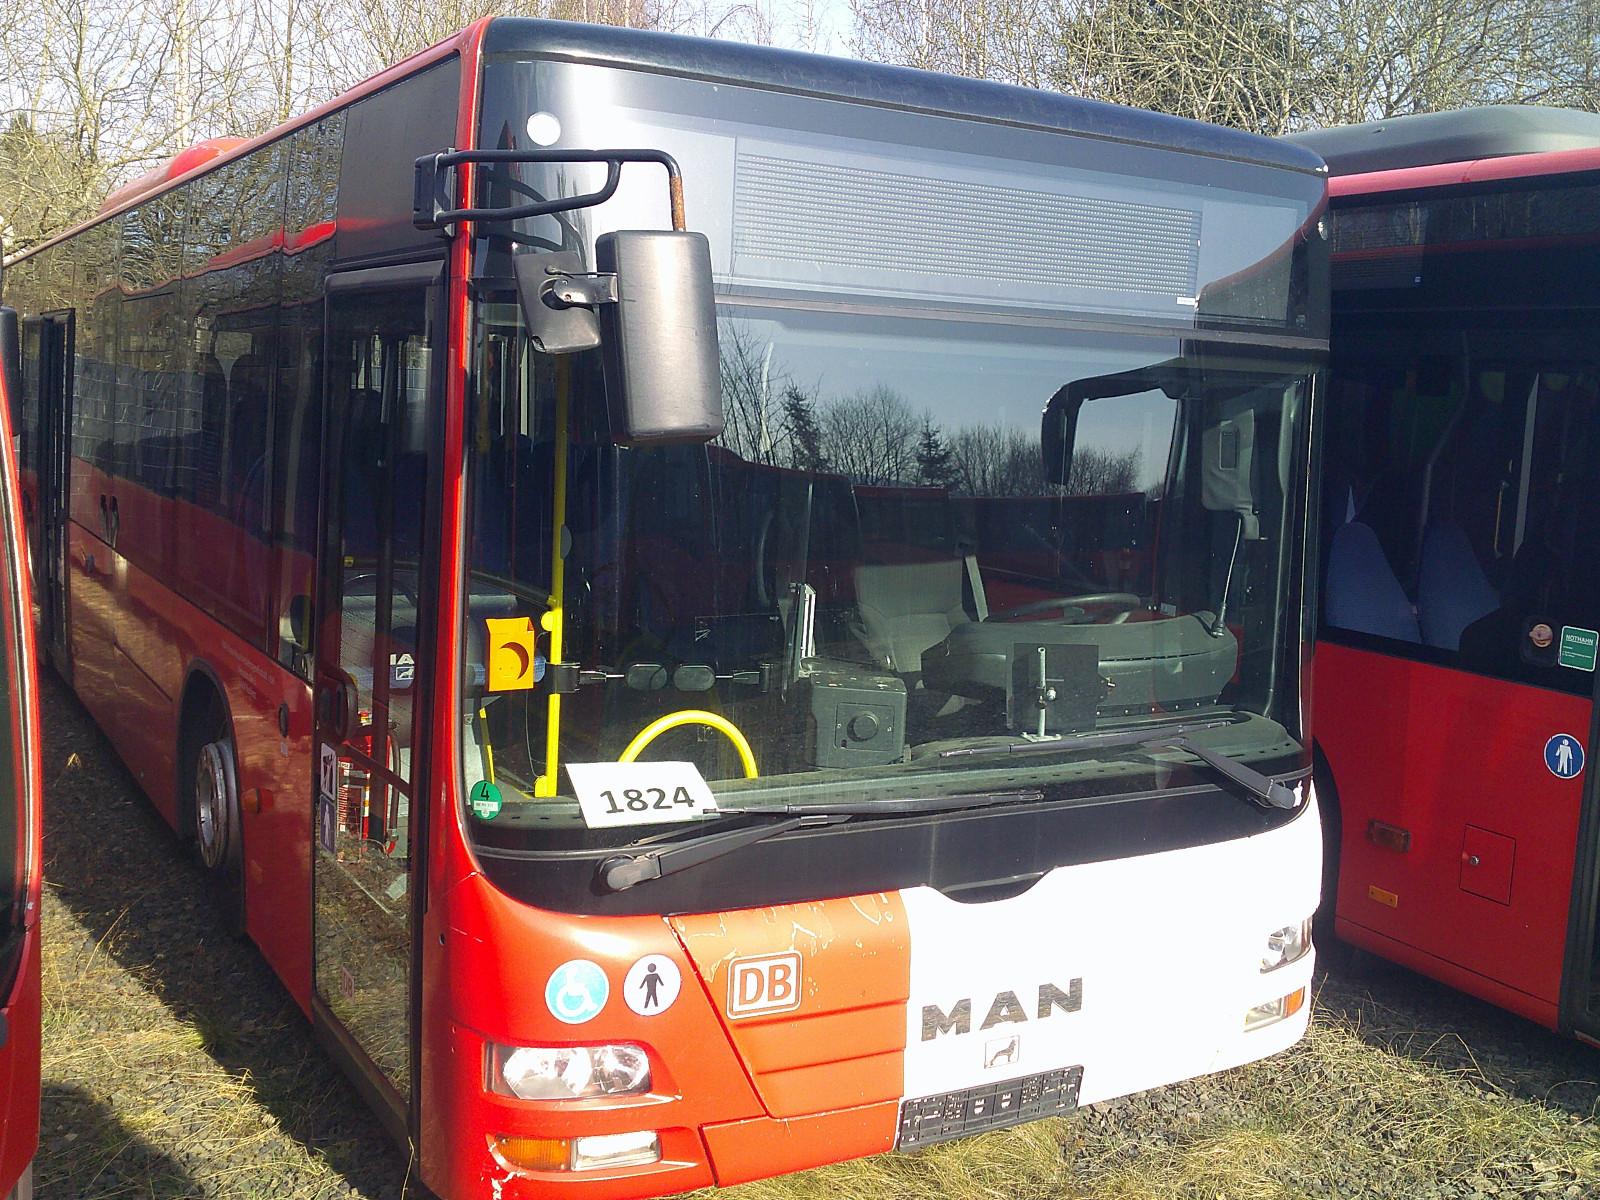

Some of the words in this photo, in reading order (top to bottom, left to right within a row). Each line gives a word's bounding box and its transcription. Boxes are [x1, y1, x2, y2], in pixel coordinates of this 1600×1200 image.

[480, 783, 490, 800] 4
[600, 786, 695, 813] 1824
[739, 964, 791, 1006] DB
[921, 978, 1082, 1041] MAN
